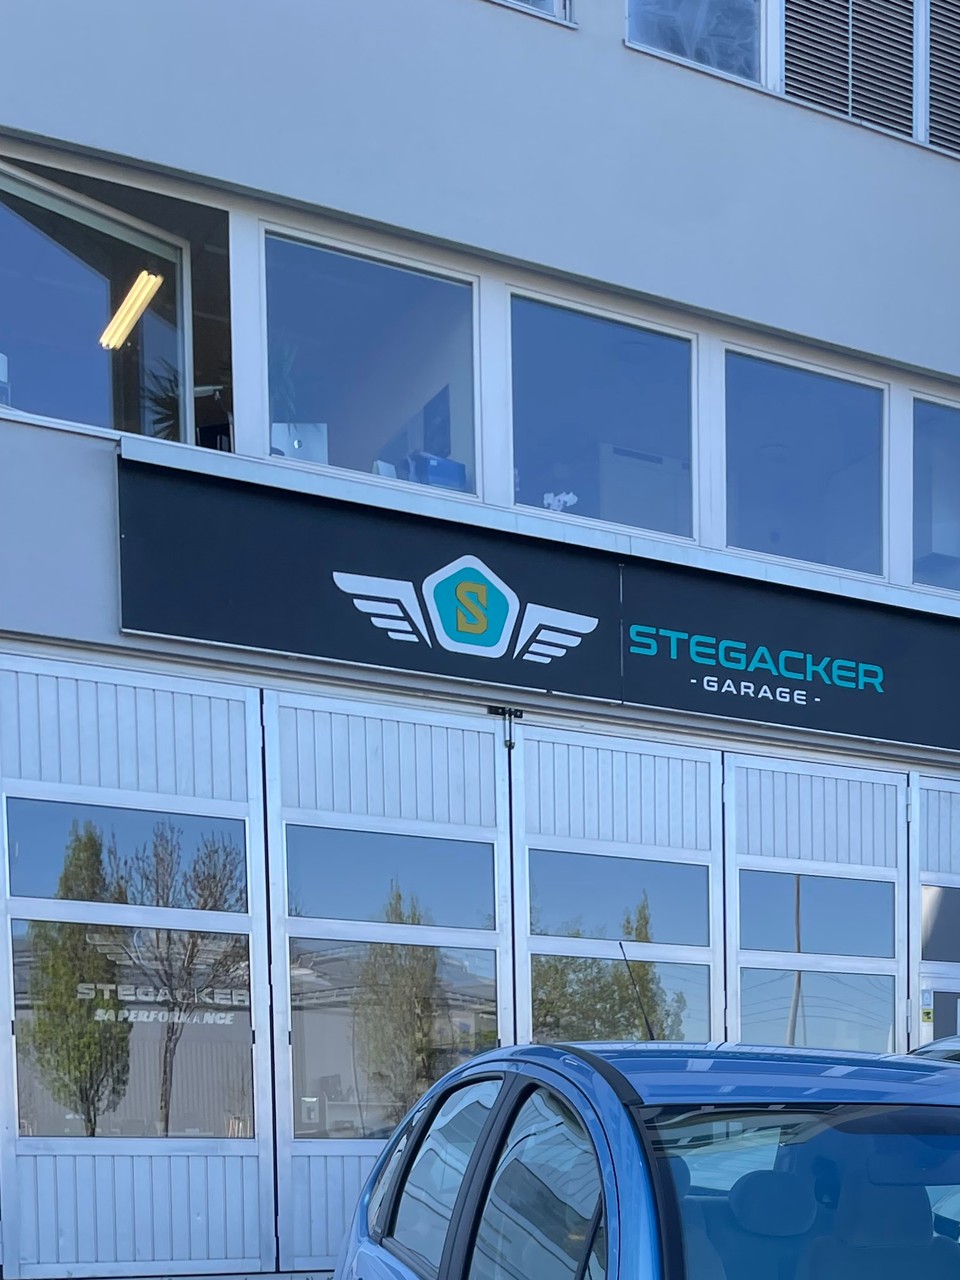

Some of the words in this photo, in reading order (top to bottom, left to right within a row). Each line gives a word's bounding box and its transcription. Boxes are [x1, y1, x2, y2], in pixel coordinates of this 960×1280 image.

[455, 581, 488, 635] S
[629, 624, 885, 693] STEGACKER
[76, 982, 250, 1005] STEGACKER
